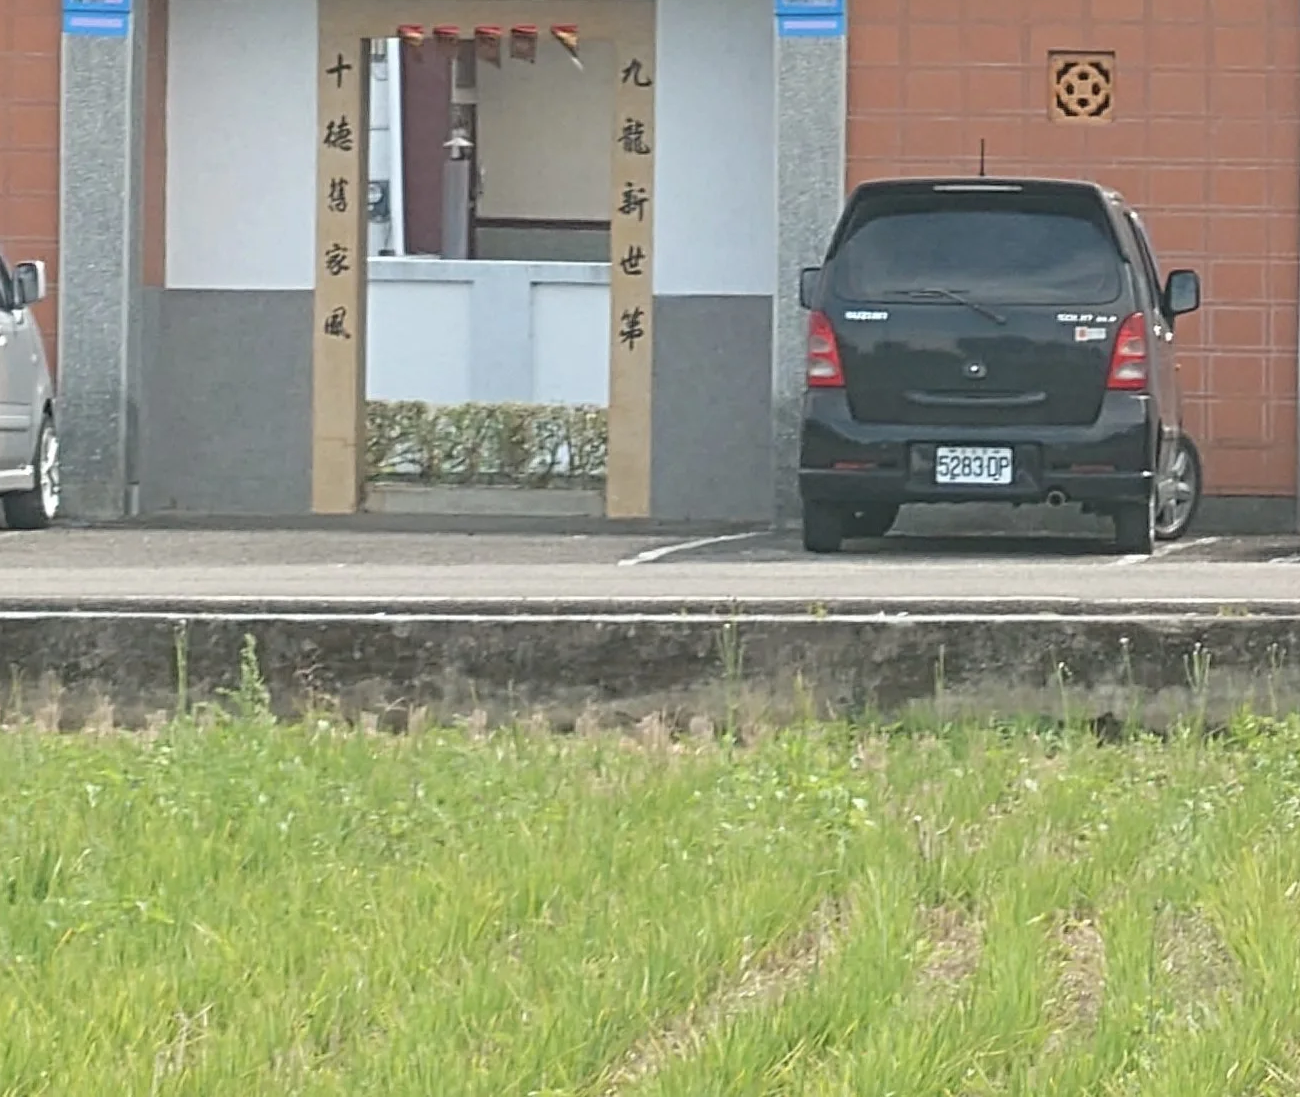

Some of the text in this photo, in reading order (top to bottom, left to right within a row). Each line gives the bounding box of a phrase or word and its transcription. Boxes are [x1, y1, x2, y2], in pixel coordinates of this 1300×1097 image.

[322, 53, 354, 340] 十德舊家風
[617, 58, 653, 351] 九龍新世第
